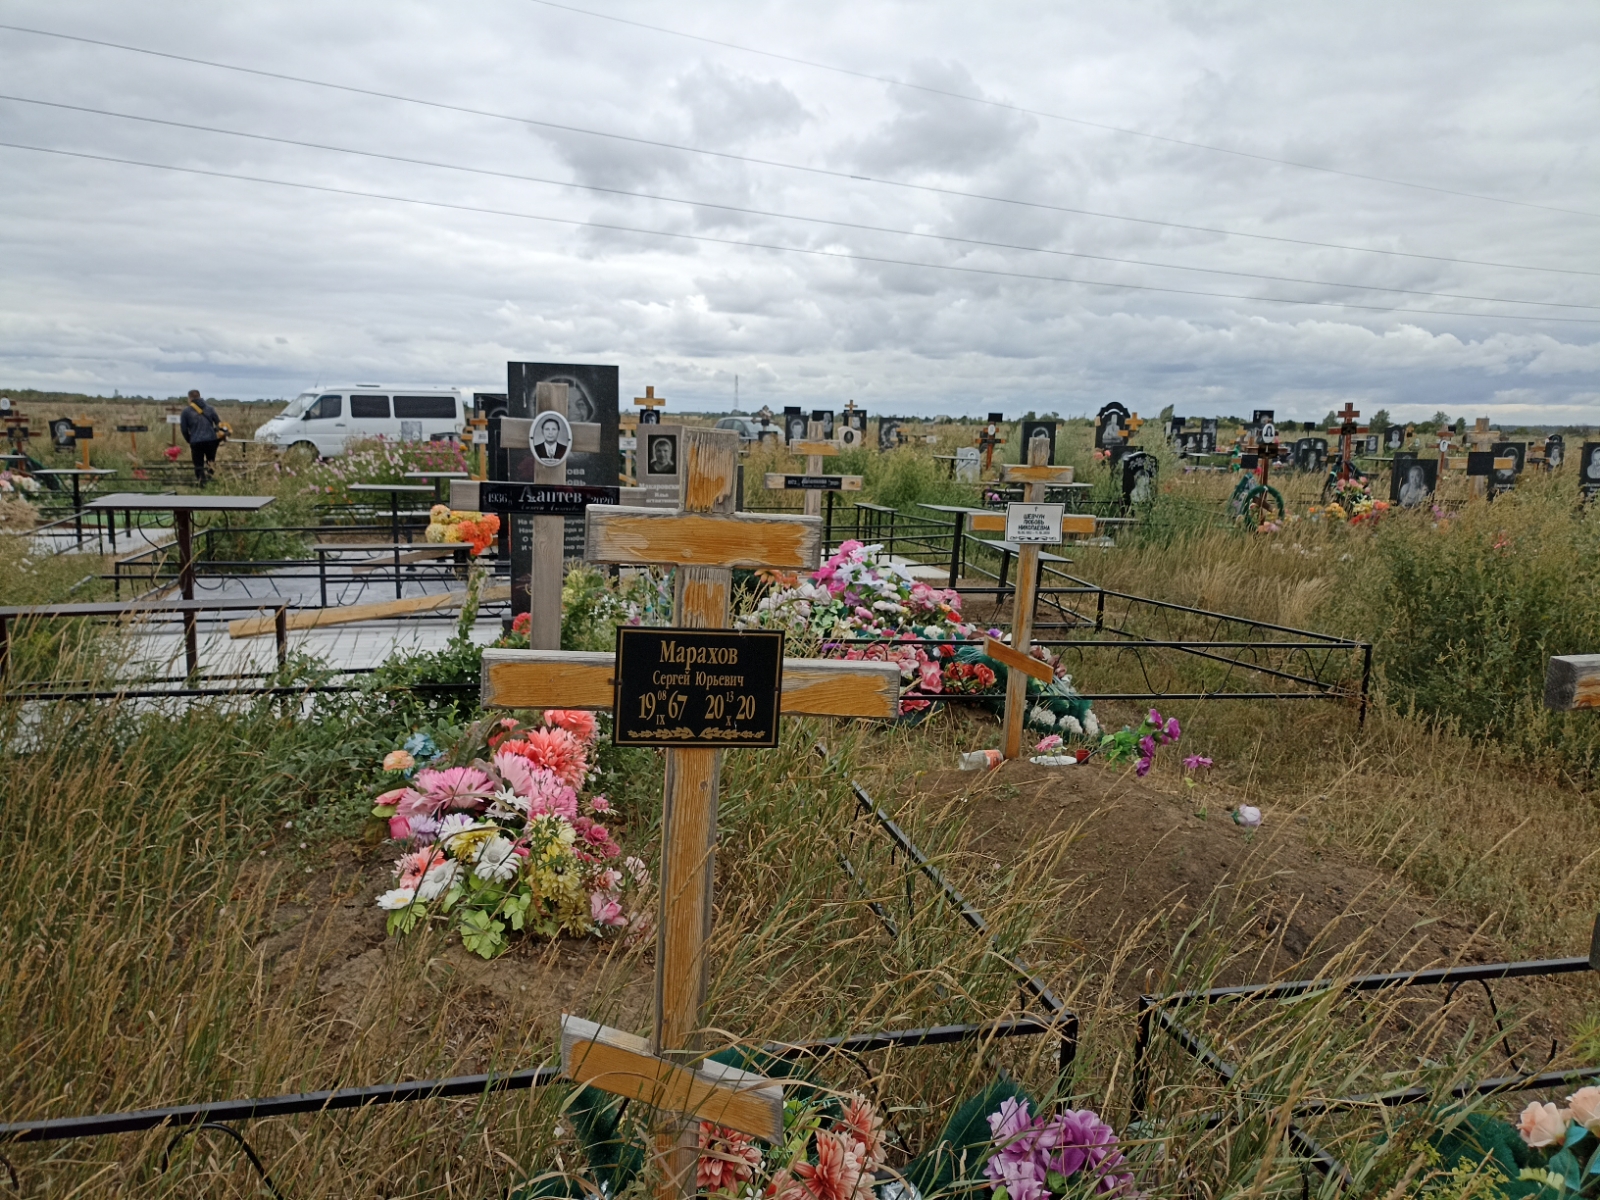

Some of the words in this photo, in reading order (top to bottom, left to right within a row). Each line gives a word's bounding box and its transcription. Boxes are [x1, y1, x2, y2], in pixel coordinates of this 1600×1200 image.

[518, 486, 582, 504] Лаптев
[659, 639, 739, 671] Марахов
[652, 669, 691, 690] Сергей
[695, 671, 744, 690] Юрьевич
[657, 690, 667, 701] 08
